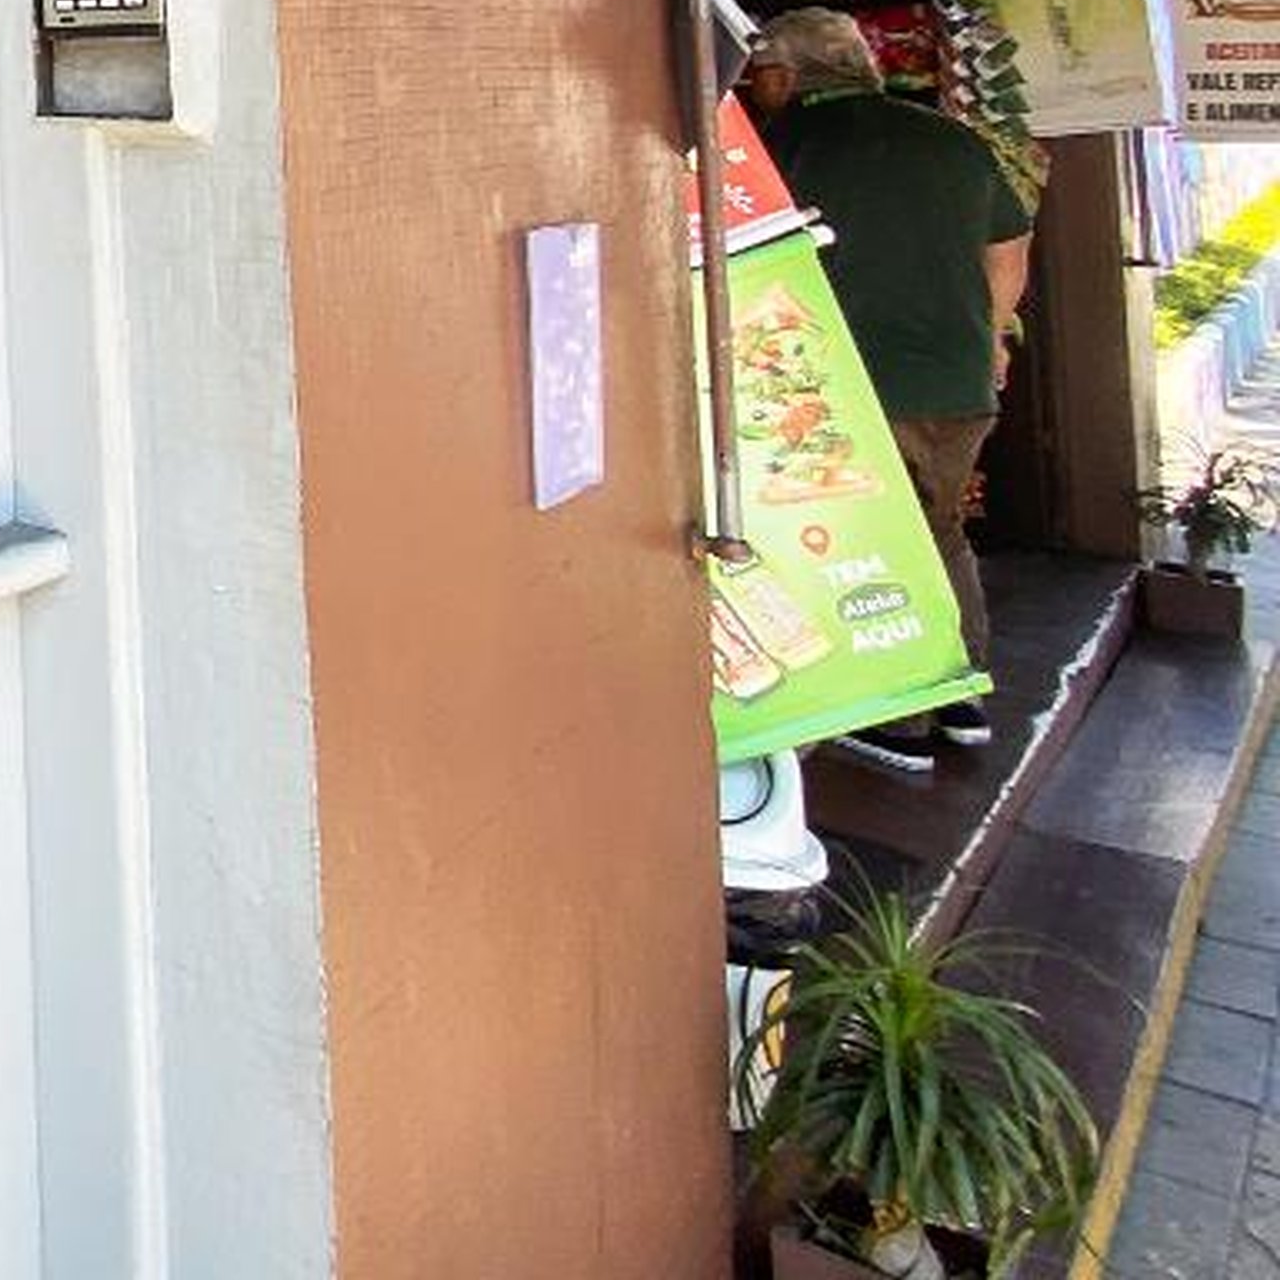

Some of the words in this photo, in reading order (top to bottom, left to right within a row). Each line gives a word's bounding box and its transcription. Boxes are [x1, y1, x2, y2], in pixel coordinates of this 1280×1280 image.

[1186, 73, 1237, 91] VALE
[1242, 73, 1280, 91] REF
[1186, 103, 1199, 120] E
